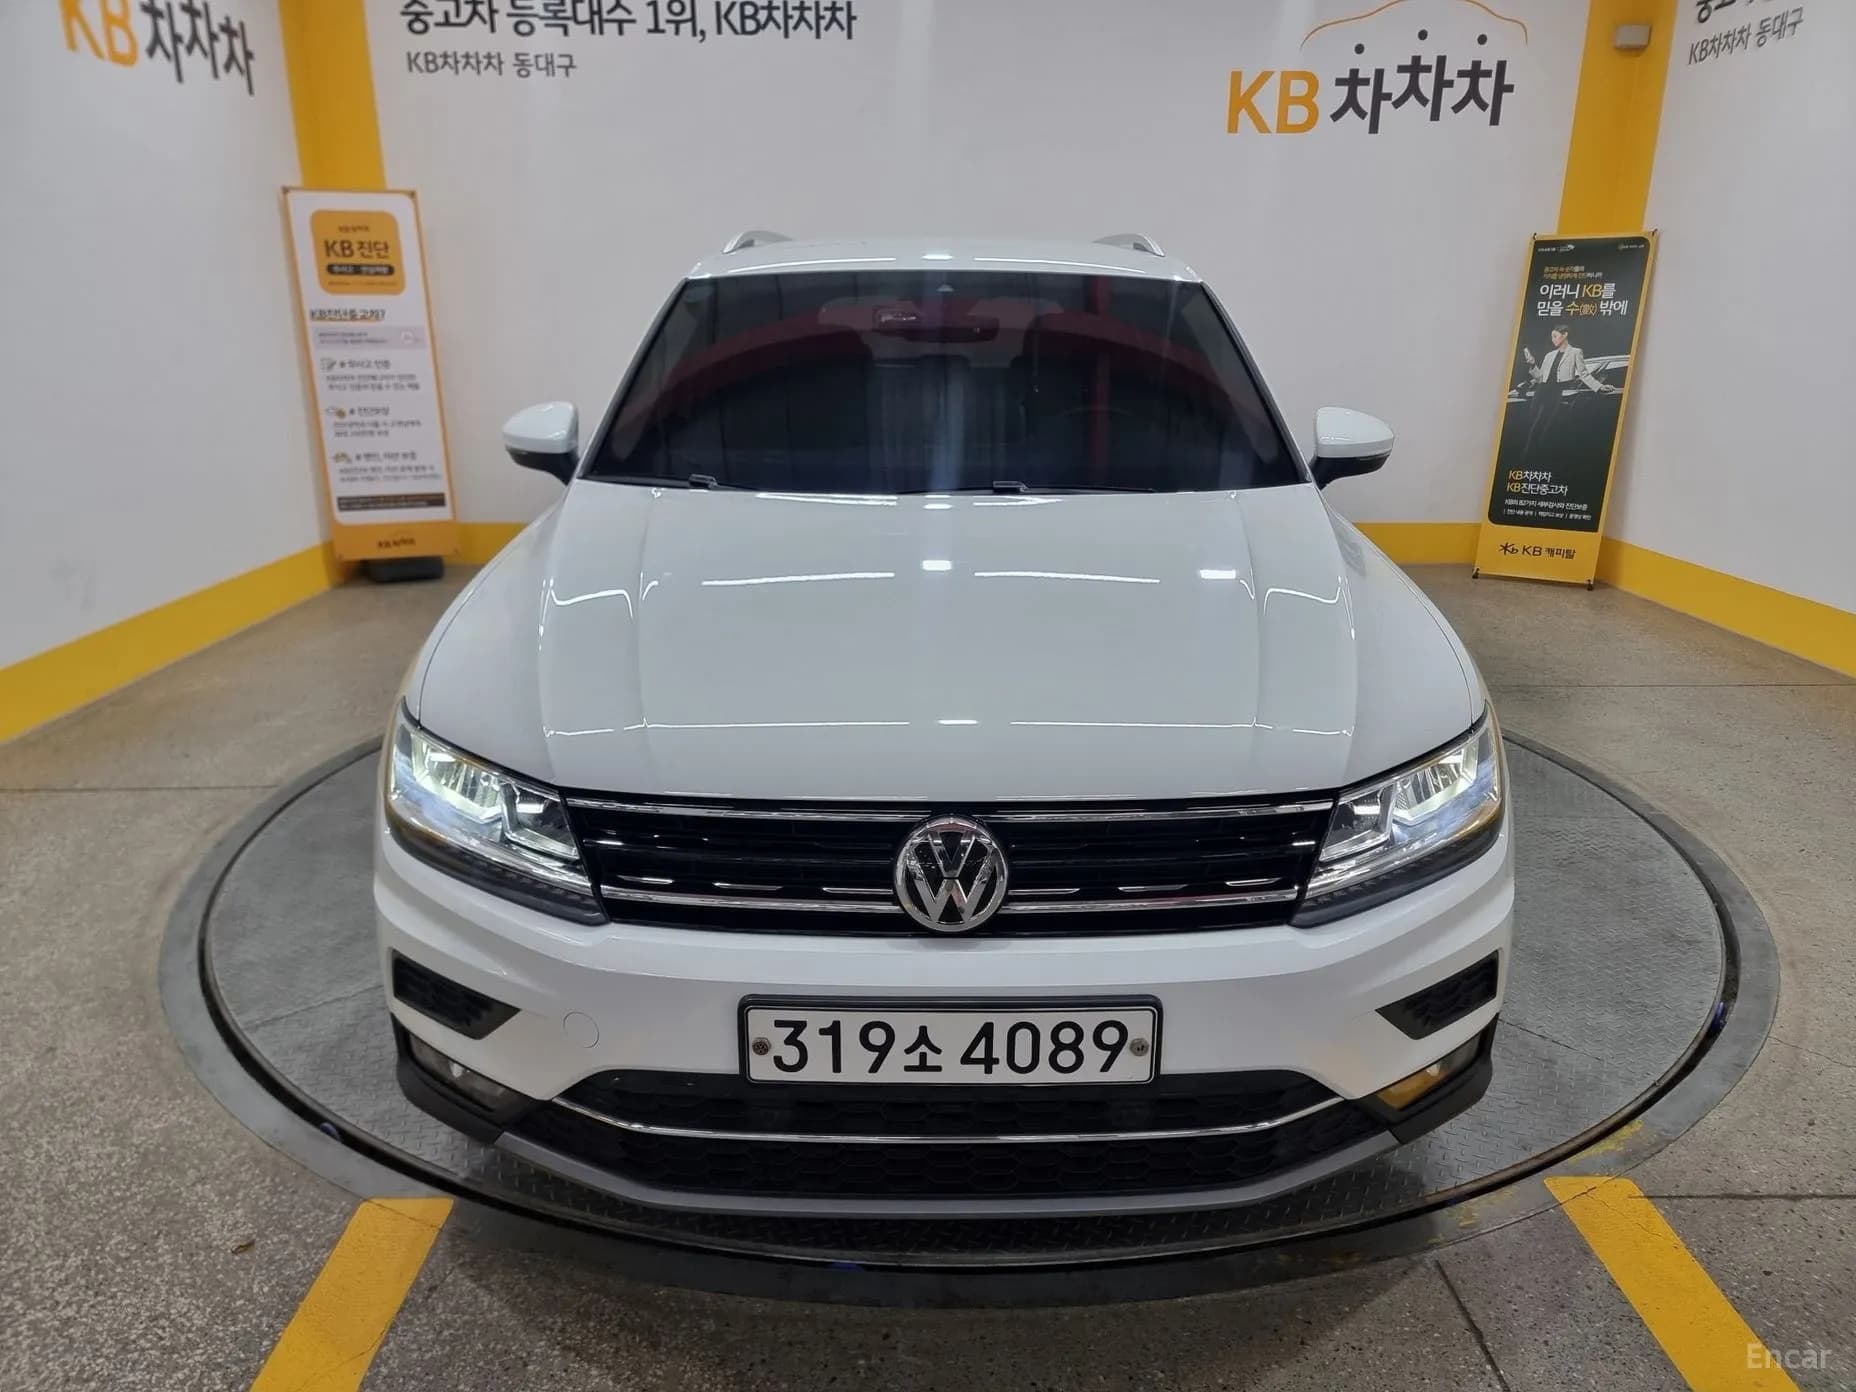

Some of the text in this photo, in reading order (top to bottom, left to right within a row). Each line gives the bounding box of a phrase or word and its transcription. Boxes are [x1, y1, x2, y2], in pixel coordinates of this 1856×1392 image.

[58, 0, 139, 66] KB
[506, 0, 637, 37] 등록대수
[646, 0, 706, 43] 1위,
[715, 0, 857, 40] KB차차차
[1688, 22, 1753, 65] KB차차차
[1755, 6, 1804, 48] 동대구
[407, 51, 577, 78] KB차차차 동대구
[1226, 29, 1515, 134] KB 차차차
[324, 239, 390, 259] KB 진단
[1540, 283, 1616, 299] 이러니 KB를
[1537, 300, 1563, 316] 믿을
[1600, 300, 1628, 316] 밖에
[1508, 470, 1552, 482] KB차차차
[1506, 483, 1568, 496] KB진단중고차
[1522, 546, 1542, 556] KB
[1545, 547, 1576, 559] 캐피탈
[773, 1019, 1129, 1075] 319소 4089
